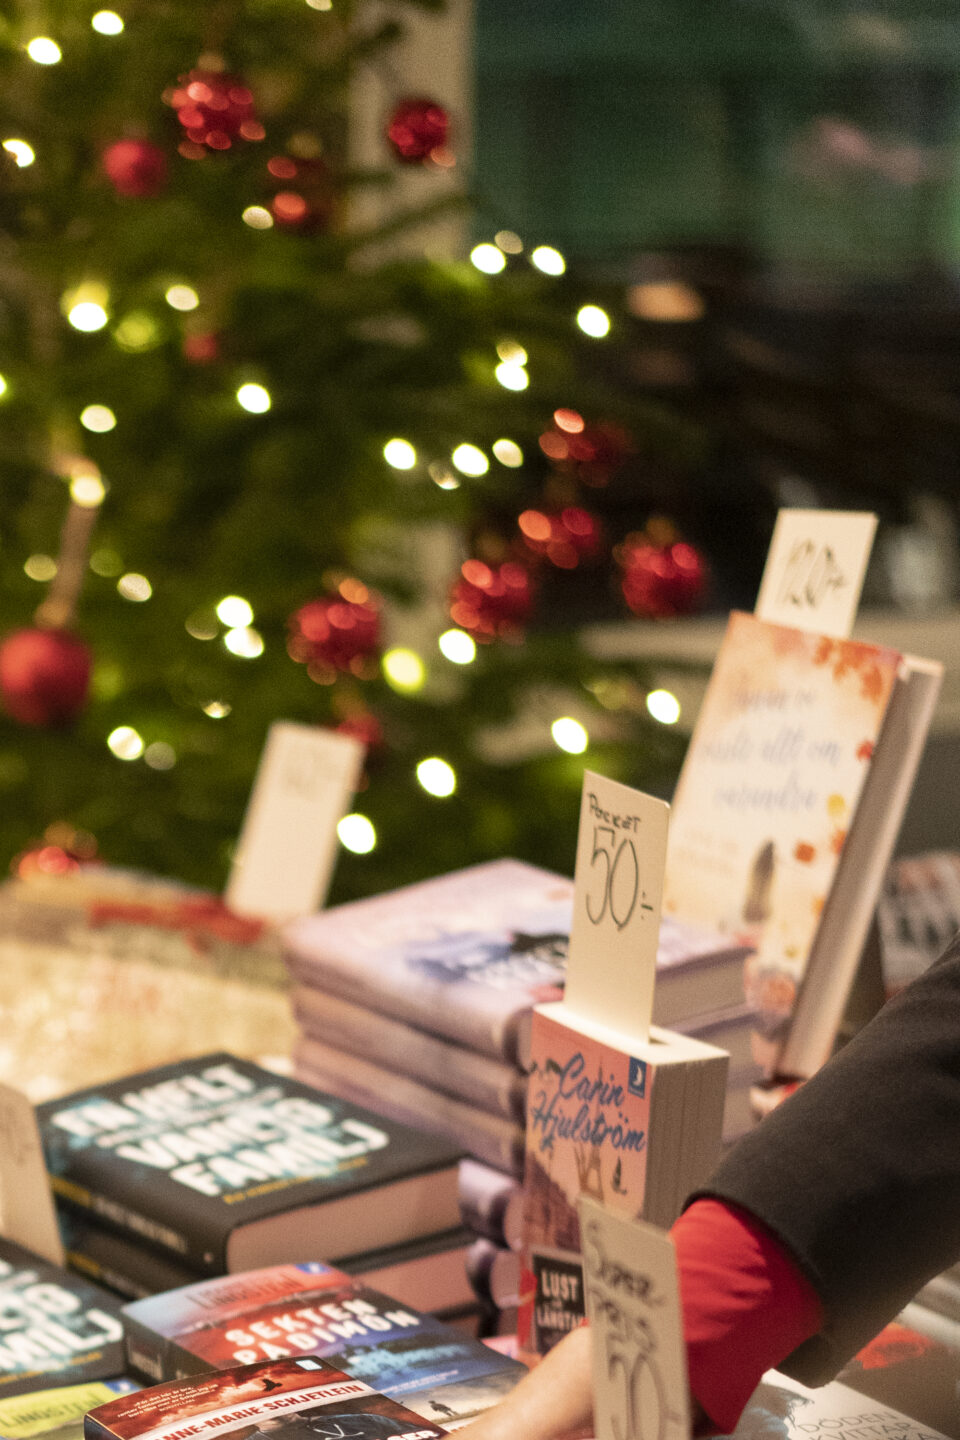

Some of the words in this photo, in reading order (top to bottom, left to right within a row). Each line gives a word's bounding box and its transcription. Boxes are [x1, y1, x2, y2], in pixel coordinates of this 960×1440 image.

[559, 1052, 625, 1107] Carin
[531, 1089, 647, 1153] Hjulström
[541, 1268, 578, 1302] LUST
[225, 1298, 380, 1348] SEKTEN
[263, 1384, 365, 1412] SCHJETLEIN
[798, 1409, 901, 1434] DÖDEN
